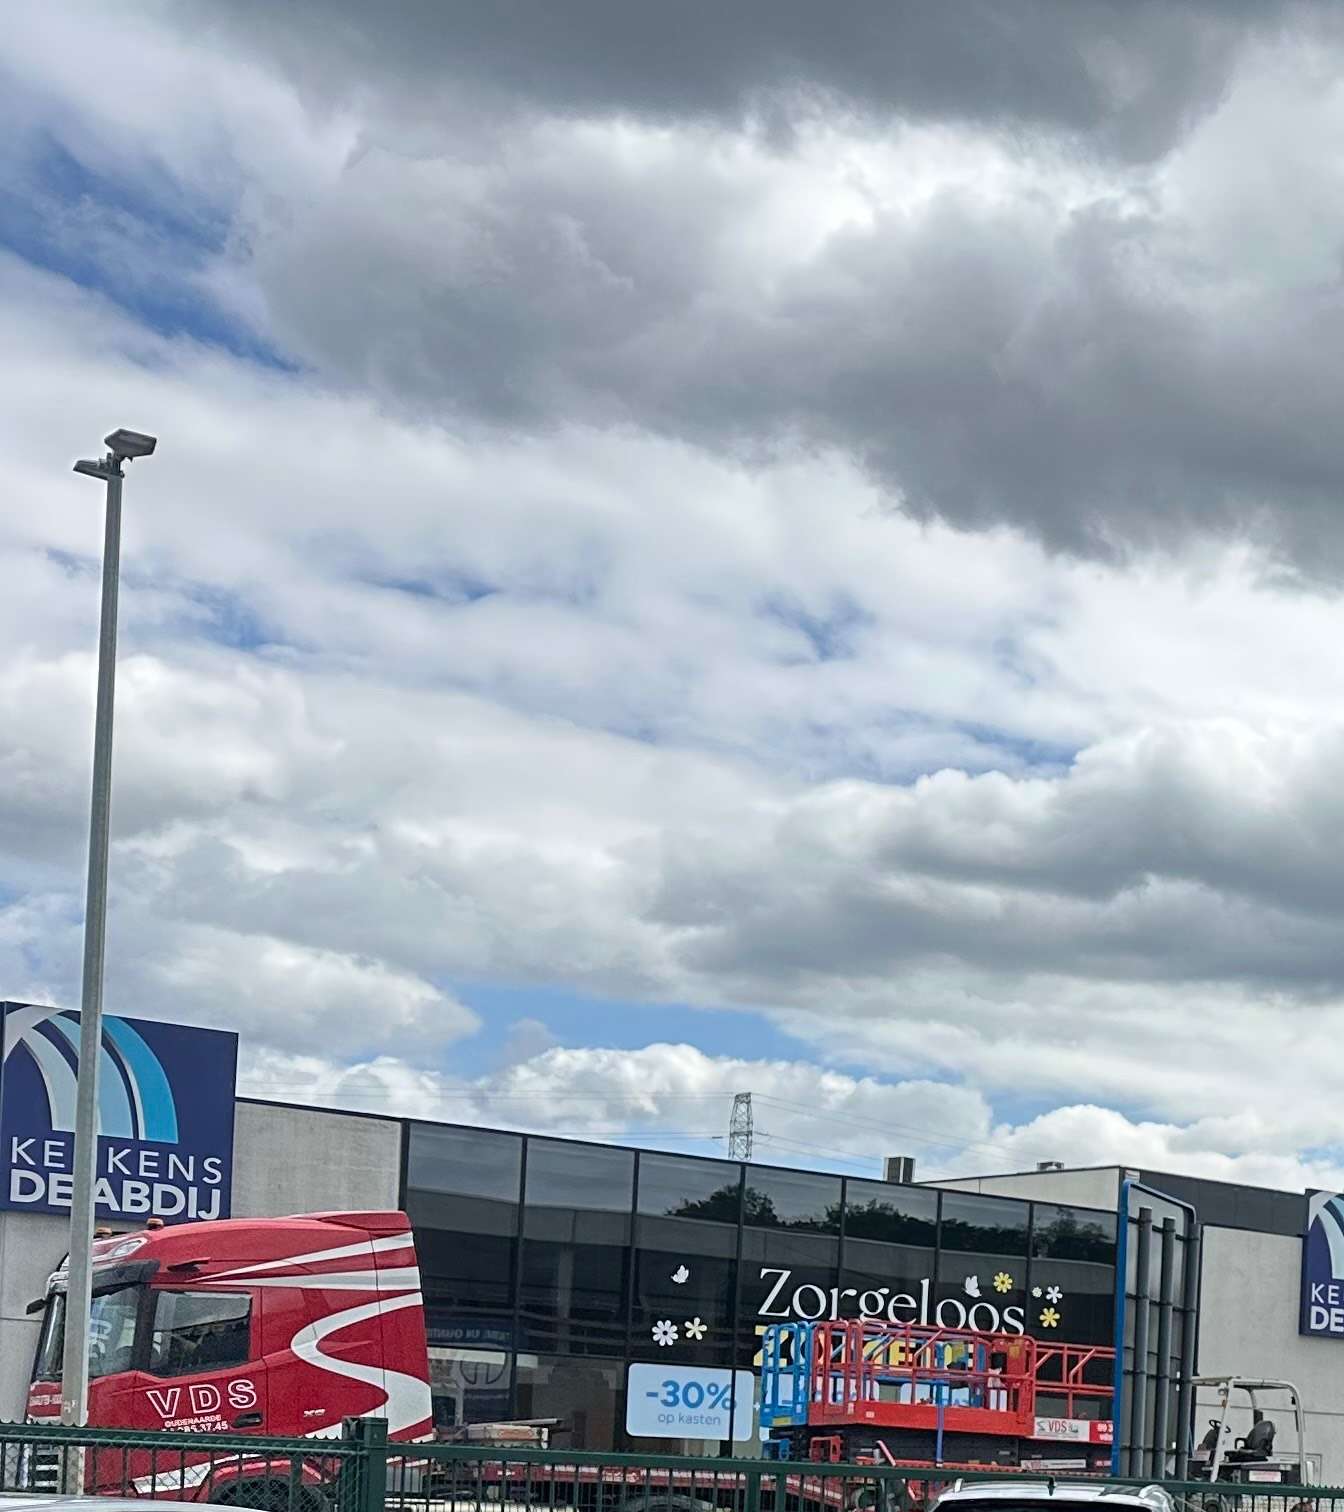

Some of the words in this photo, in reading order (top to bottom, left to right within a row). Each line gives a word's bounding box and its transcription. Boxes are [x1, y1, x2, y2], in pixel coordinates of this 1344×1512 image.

[11, 1136, 222, 1184] KEKENS
[9, 1168, 74, 1207] DE
[94, 1177, 221, 1220] ABDIJ
[757, 1267, 1026, 1337] Zorgeloos
[1310, 1305, 1344, 1332] DE
[146, 1379, 257, 1418] VDS
[646, 1379, 737, 1410] -30%
[164, 1414, 222, 1428] OUDENAARDE
[657, 1413, 675, 1424] op
[678, 1412, 722, 1425] kasten
[1048, 1420, 1067, 1434] VDS
